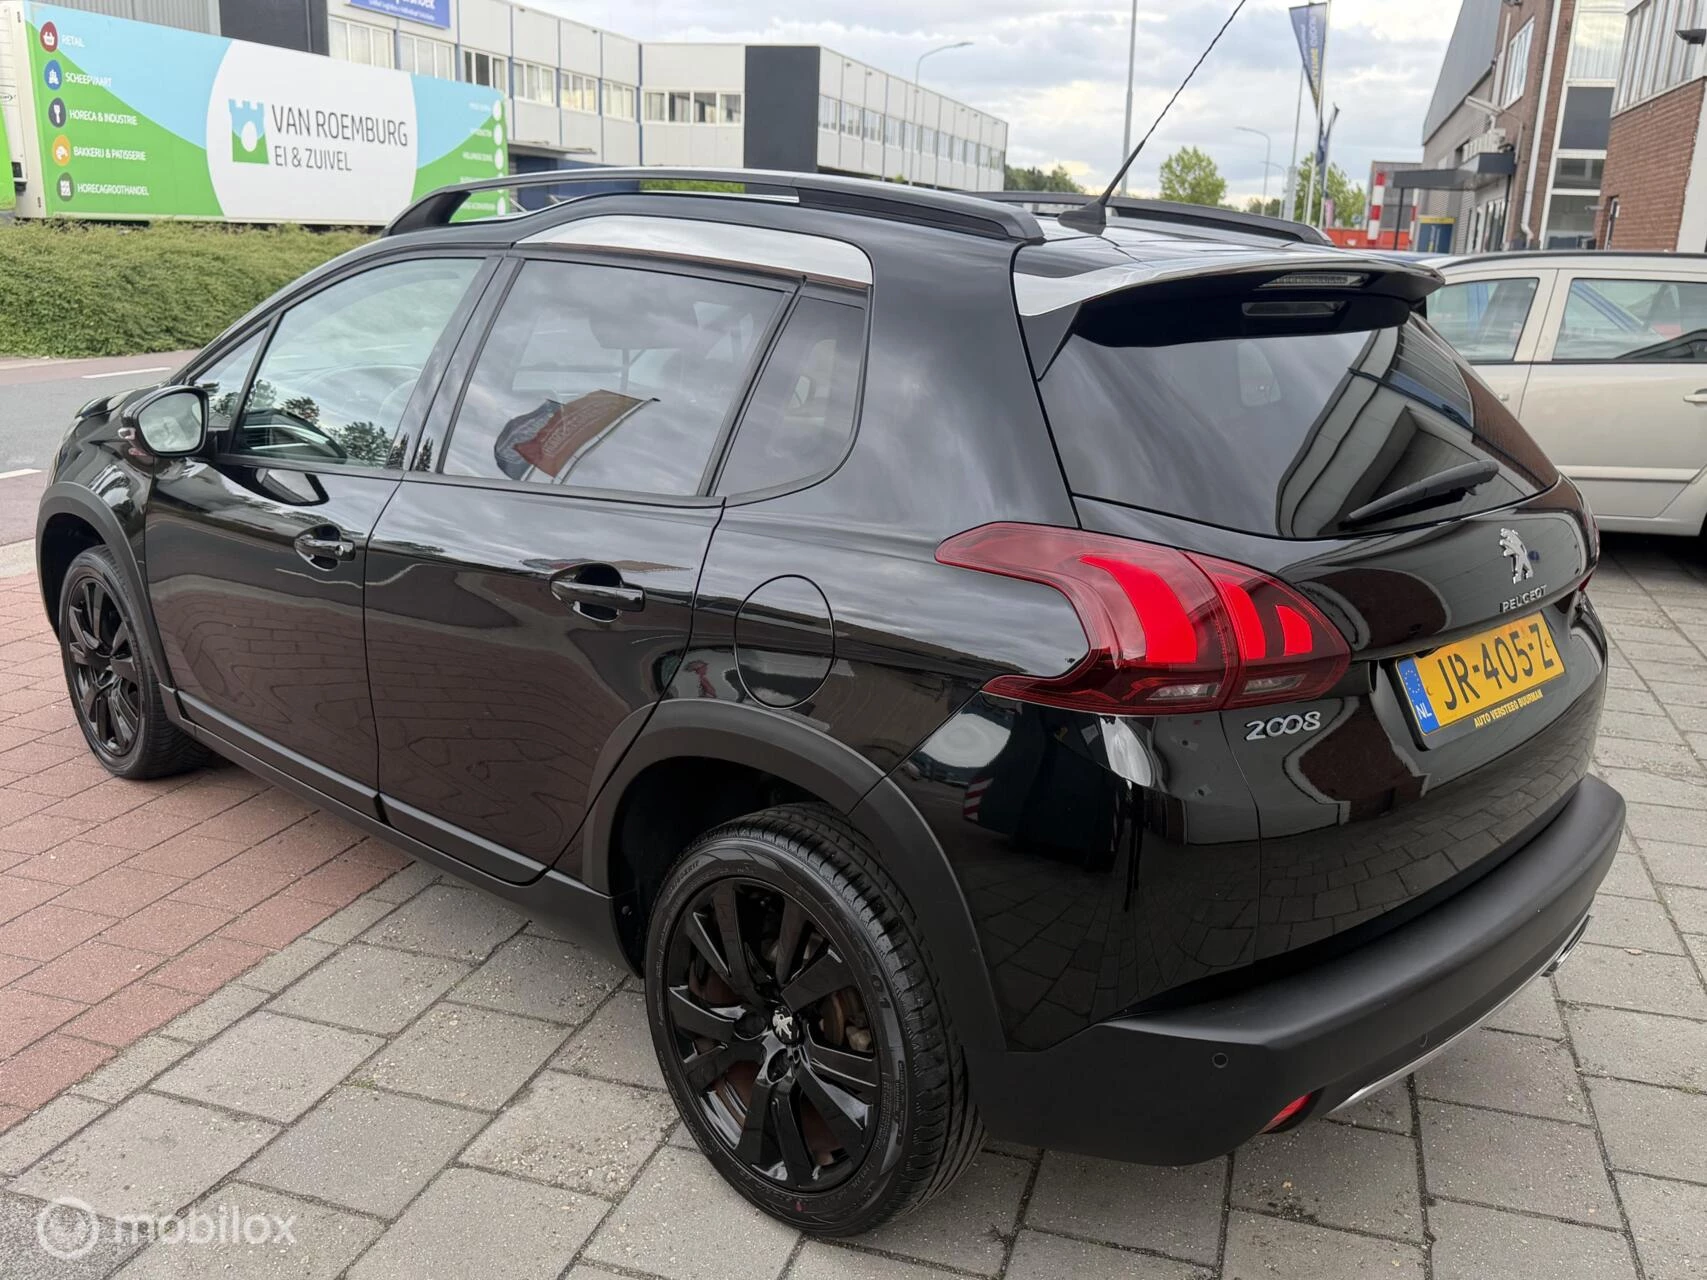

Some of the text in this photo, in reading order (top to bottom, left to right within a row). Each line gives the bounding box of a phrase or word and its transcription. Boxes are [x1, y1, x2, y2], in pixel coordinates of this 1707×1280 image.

[61, 34, 85, 48] RETAIL
[65, 72, 112, 87] SCHEEPVAART
[69, 109, 138, 126] HORECA & INDUSTRIE
[271, 104, 408, 147] VAN ROEMBURG
[105, 148, 111, 159] &
[111, 148, 147, 161] PATISSERIE
[274, 145, 352, 171] EI & ZUIVEL
[77, 183, 150, 196] HORECAGROOTHANDEL
[1502, 584, 1547, 613] PEUGEOT
[1437, 623, 1554, 711] JR-405-Z
[1415, 702, 1433, 720] NL
[1245, 711, 1321, 740] 2008
[1474, 712, 1492, 728] AUTO
